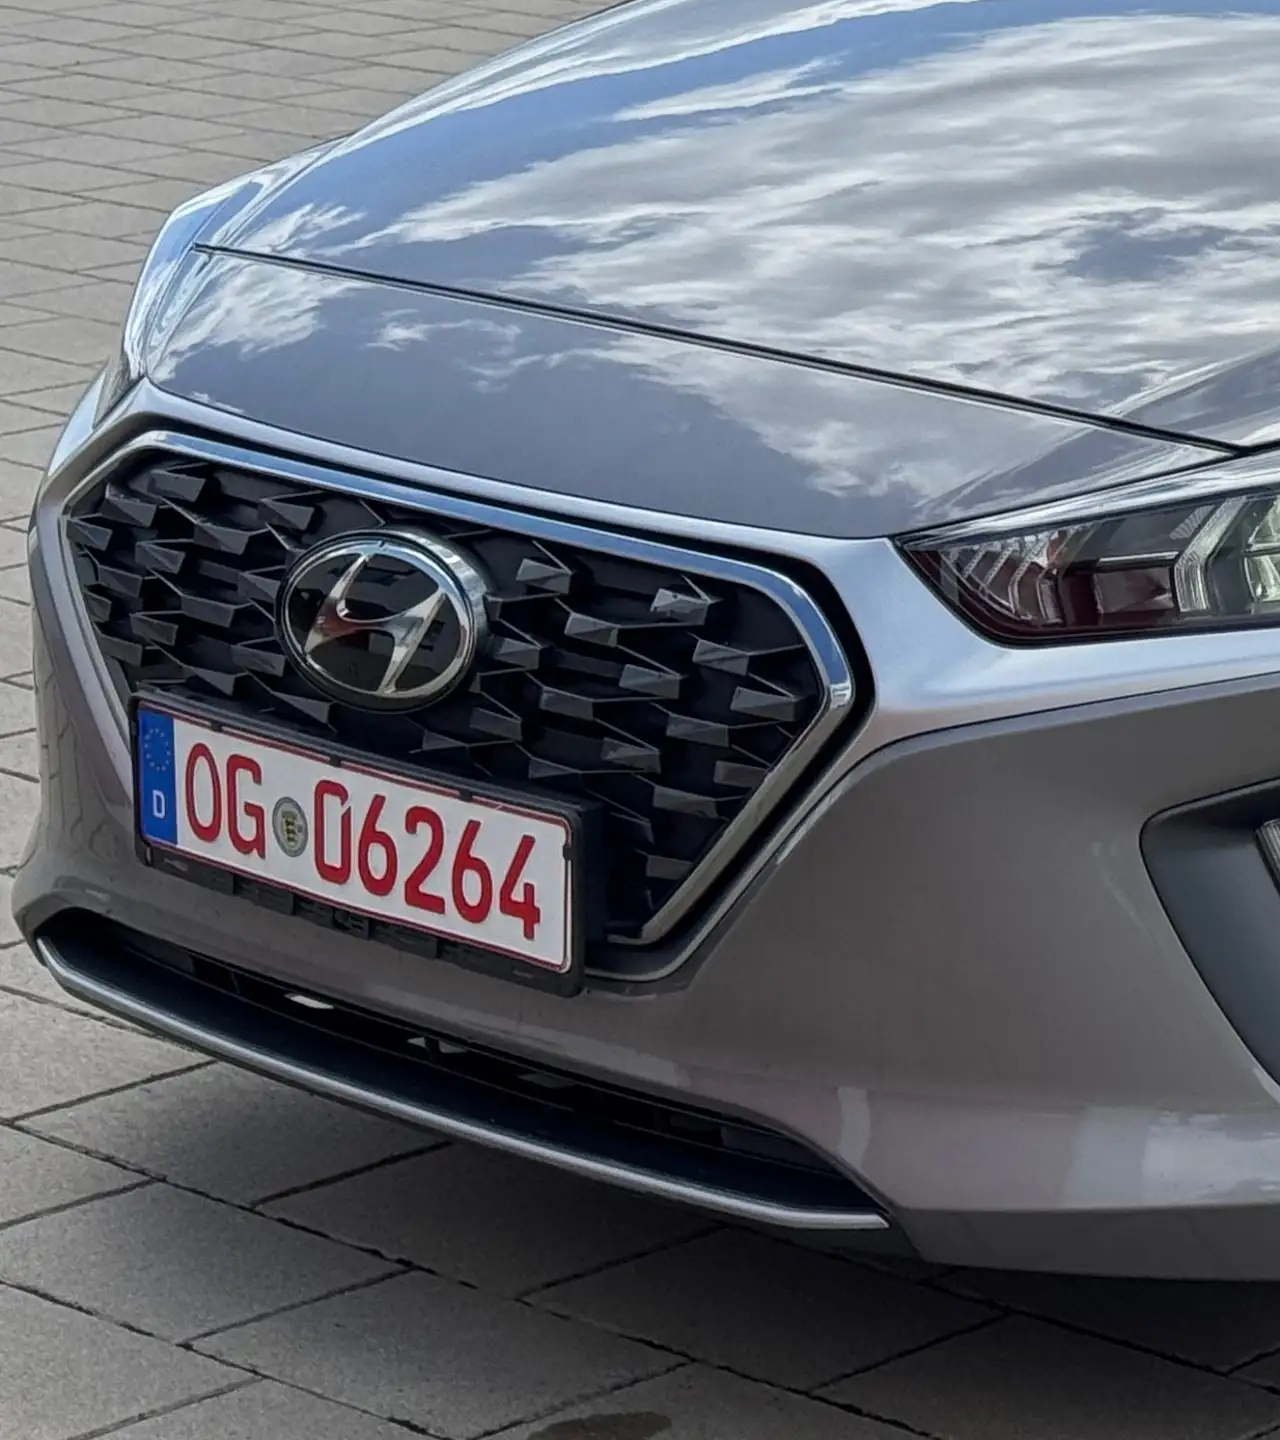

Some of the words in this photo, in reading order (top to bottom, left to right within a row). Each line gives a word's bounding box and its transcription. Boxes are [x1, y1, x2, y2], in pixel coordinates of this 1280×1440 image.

[152, 789, 166, 820] D
[185, 742, 266, 859] OG
[313, 779, 541, 941] 06264
